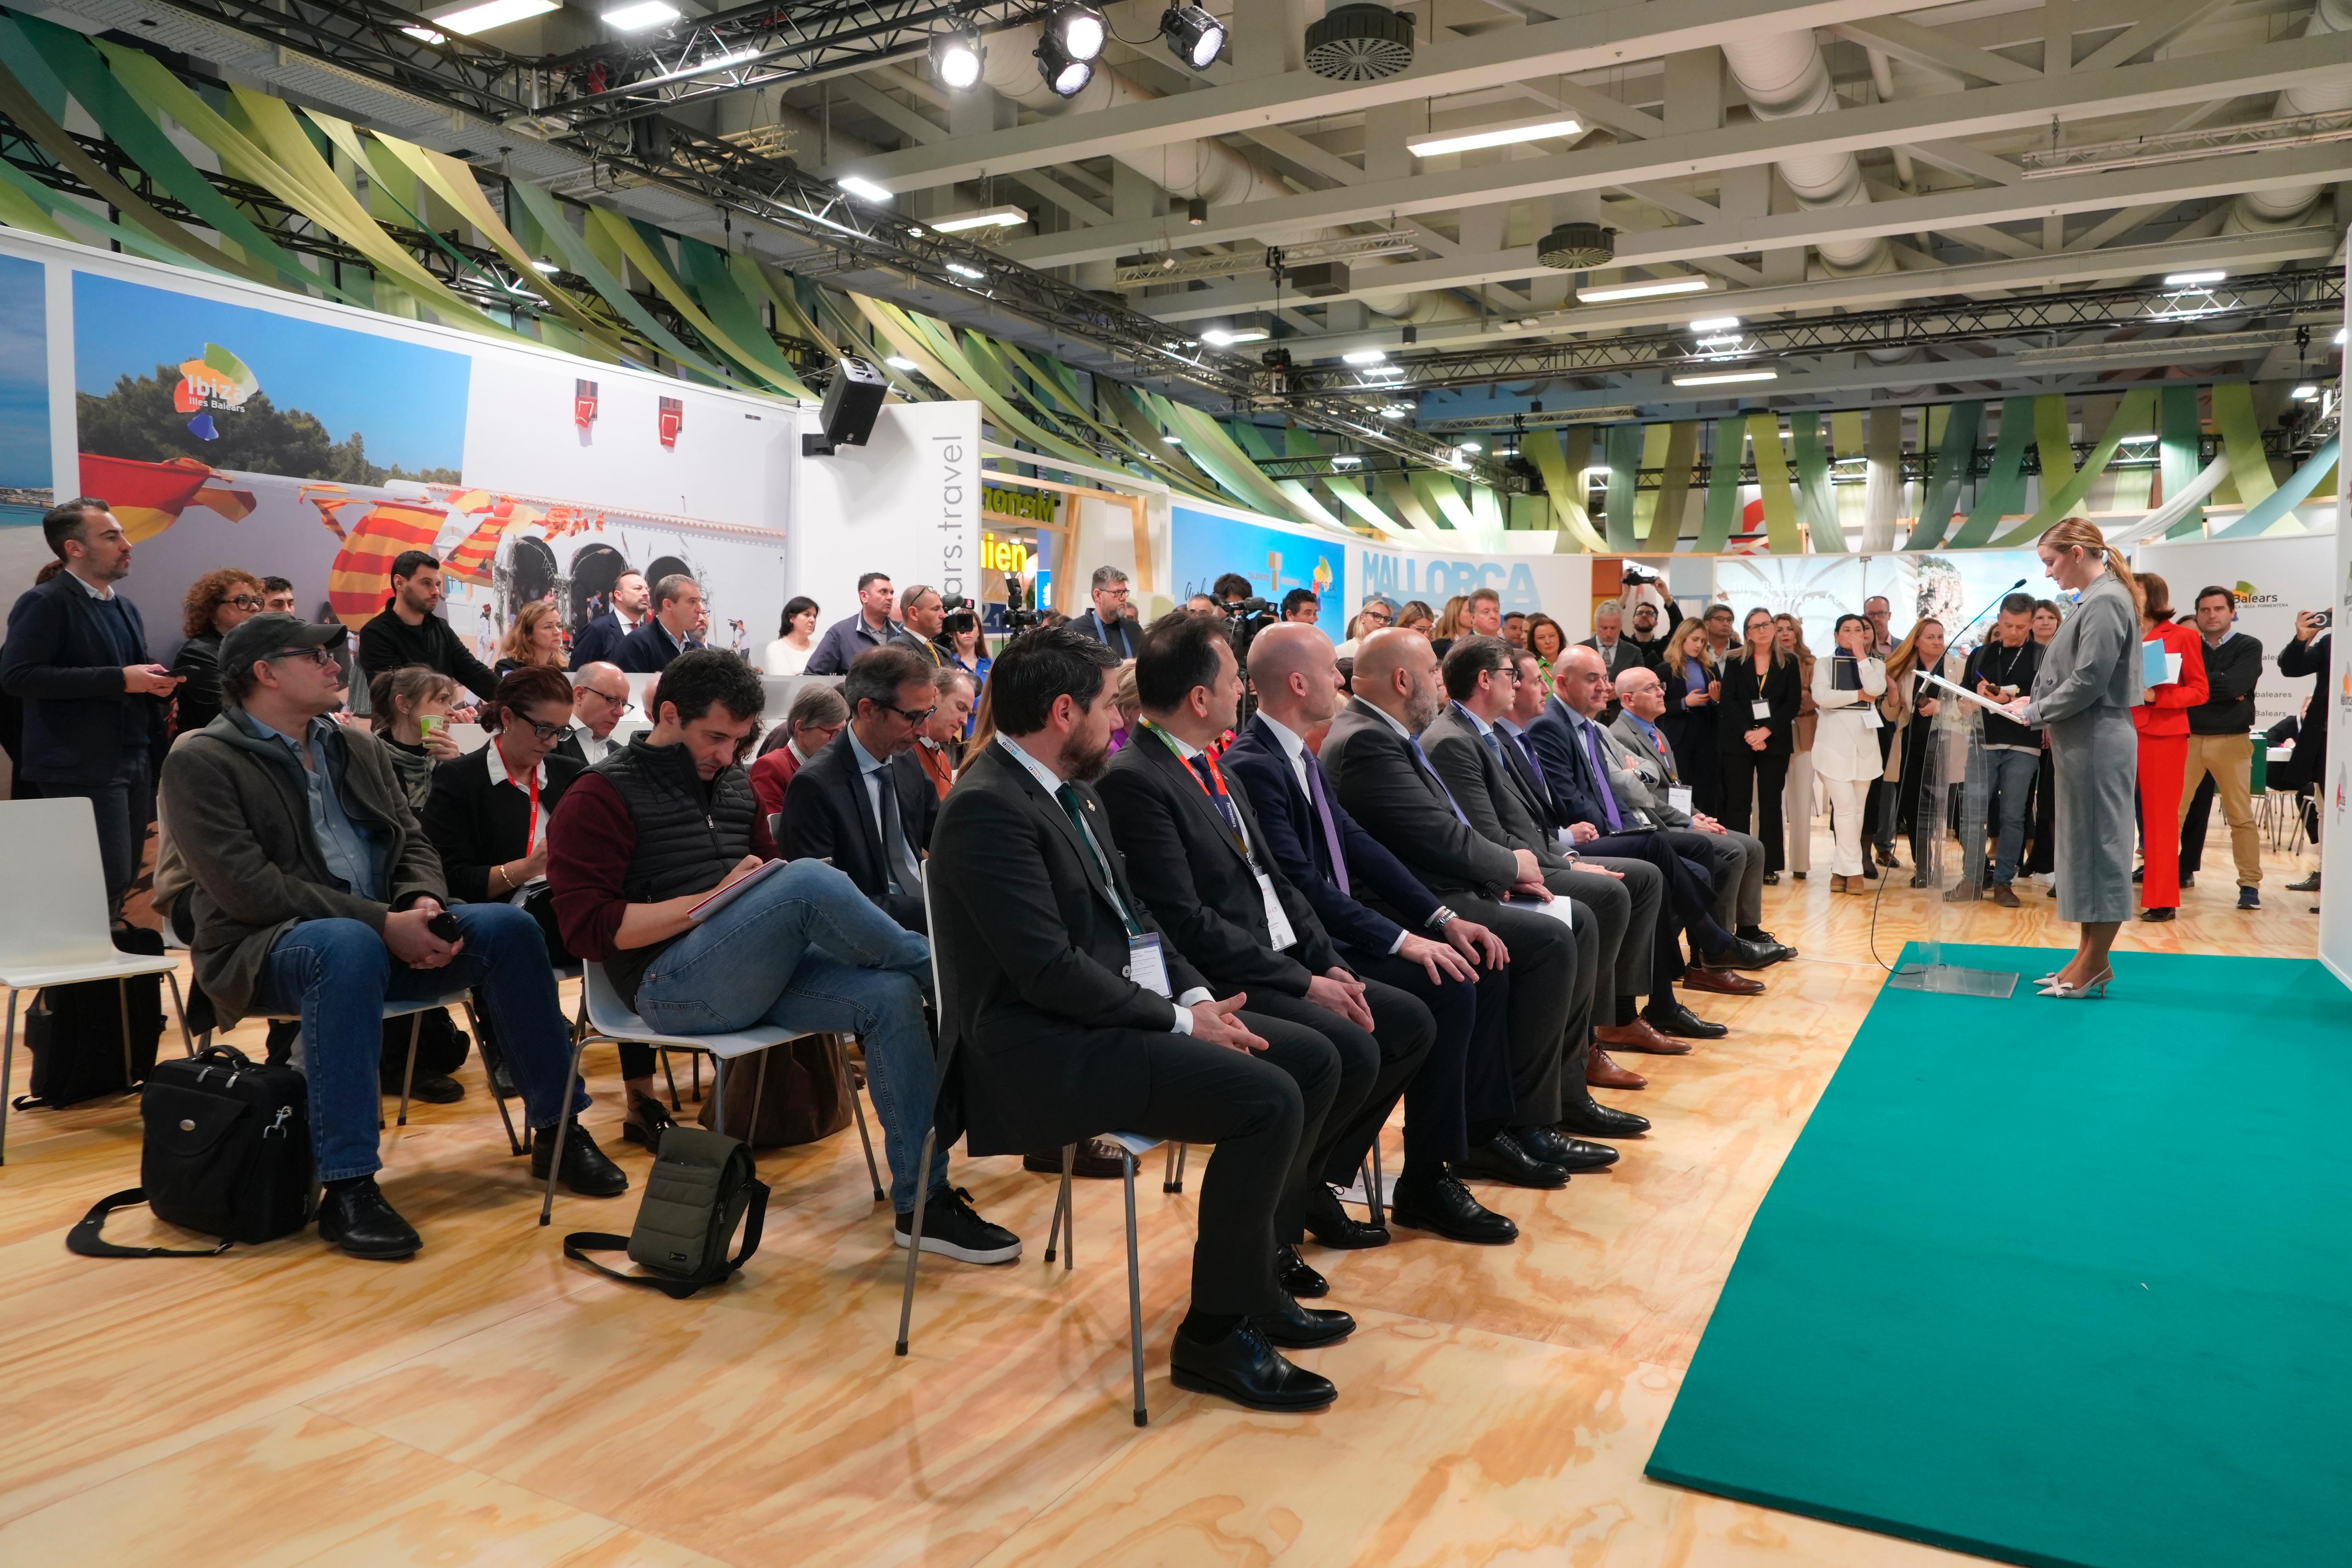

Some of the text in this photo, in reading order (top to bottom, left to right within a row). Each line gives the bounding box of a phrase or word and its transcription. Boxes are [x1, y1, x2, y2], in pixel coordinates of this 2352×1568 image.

[188, 374, 245, 402] Ibiza
[189, 396, 245, 413] Illes Balears
[932, 436, 962, 597] ars.travel
[1363, 550, 1541, 604] MALLORCA
[1732, 581, 1758, 592] Illes
[2234, 594, 2278, 604] Balears
[1157, 729, 1172, 747] Menorca
[1226, 802, 1237, 828] Formentera
